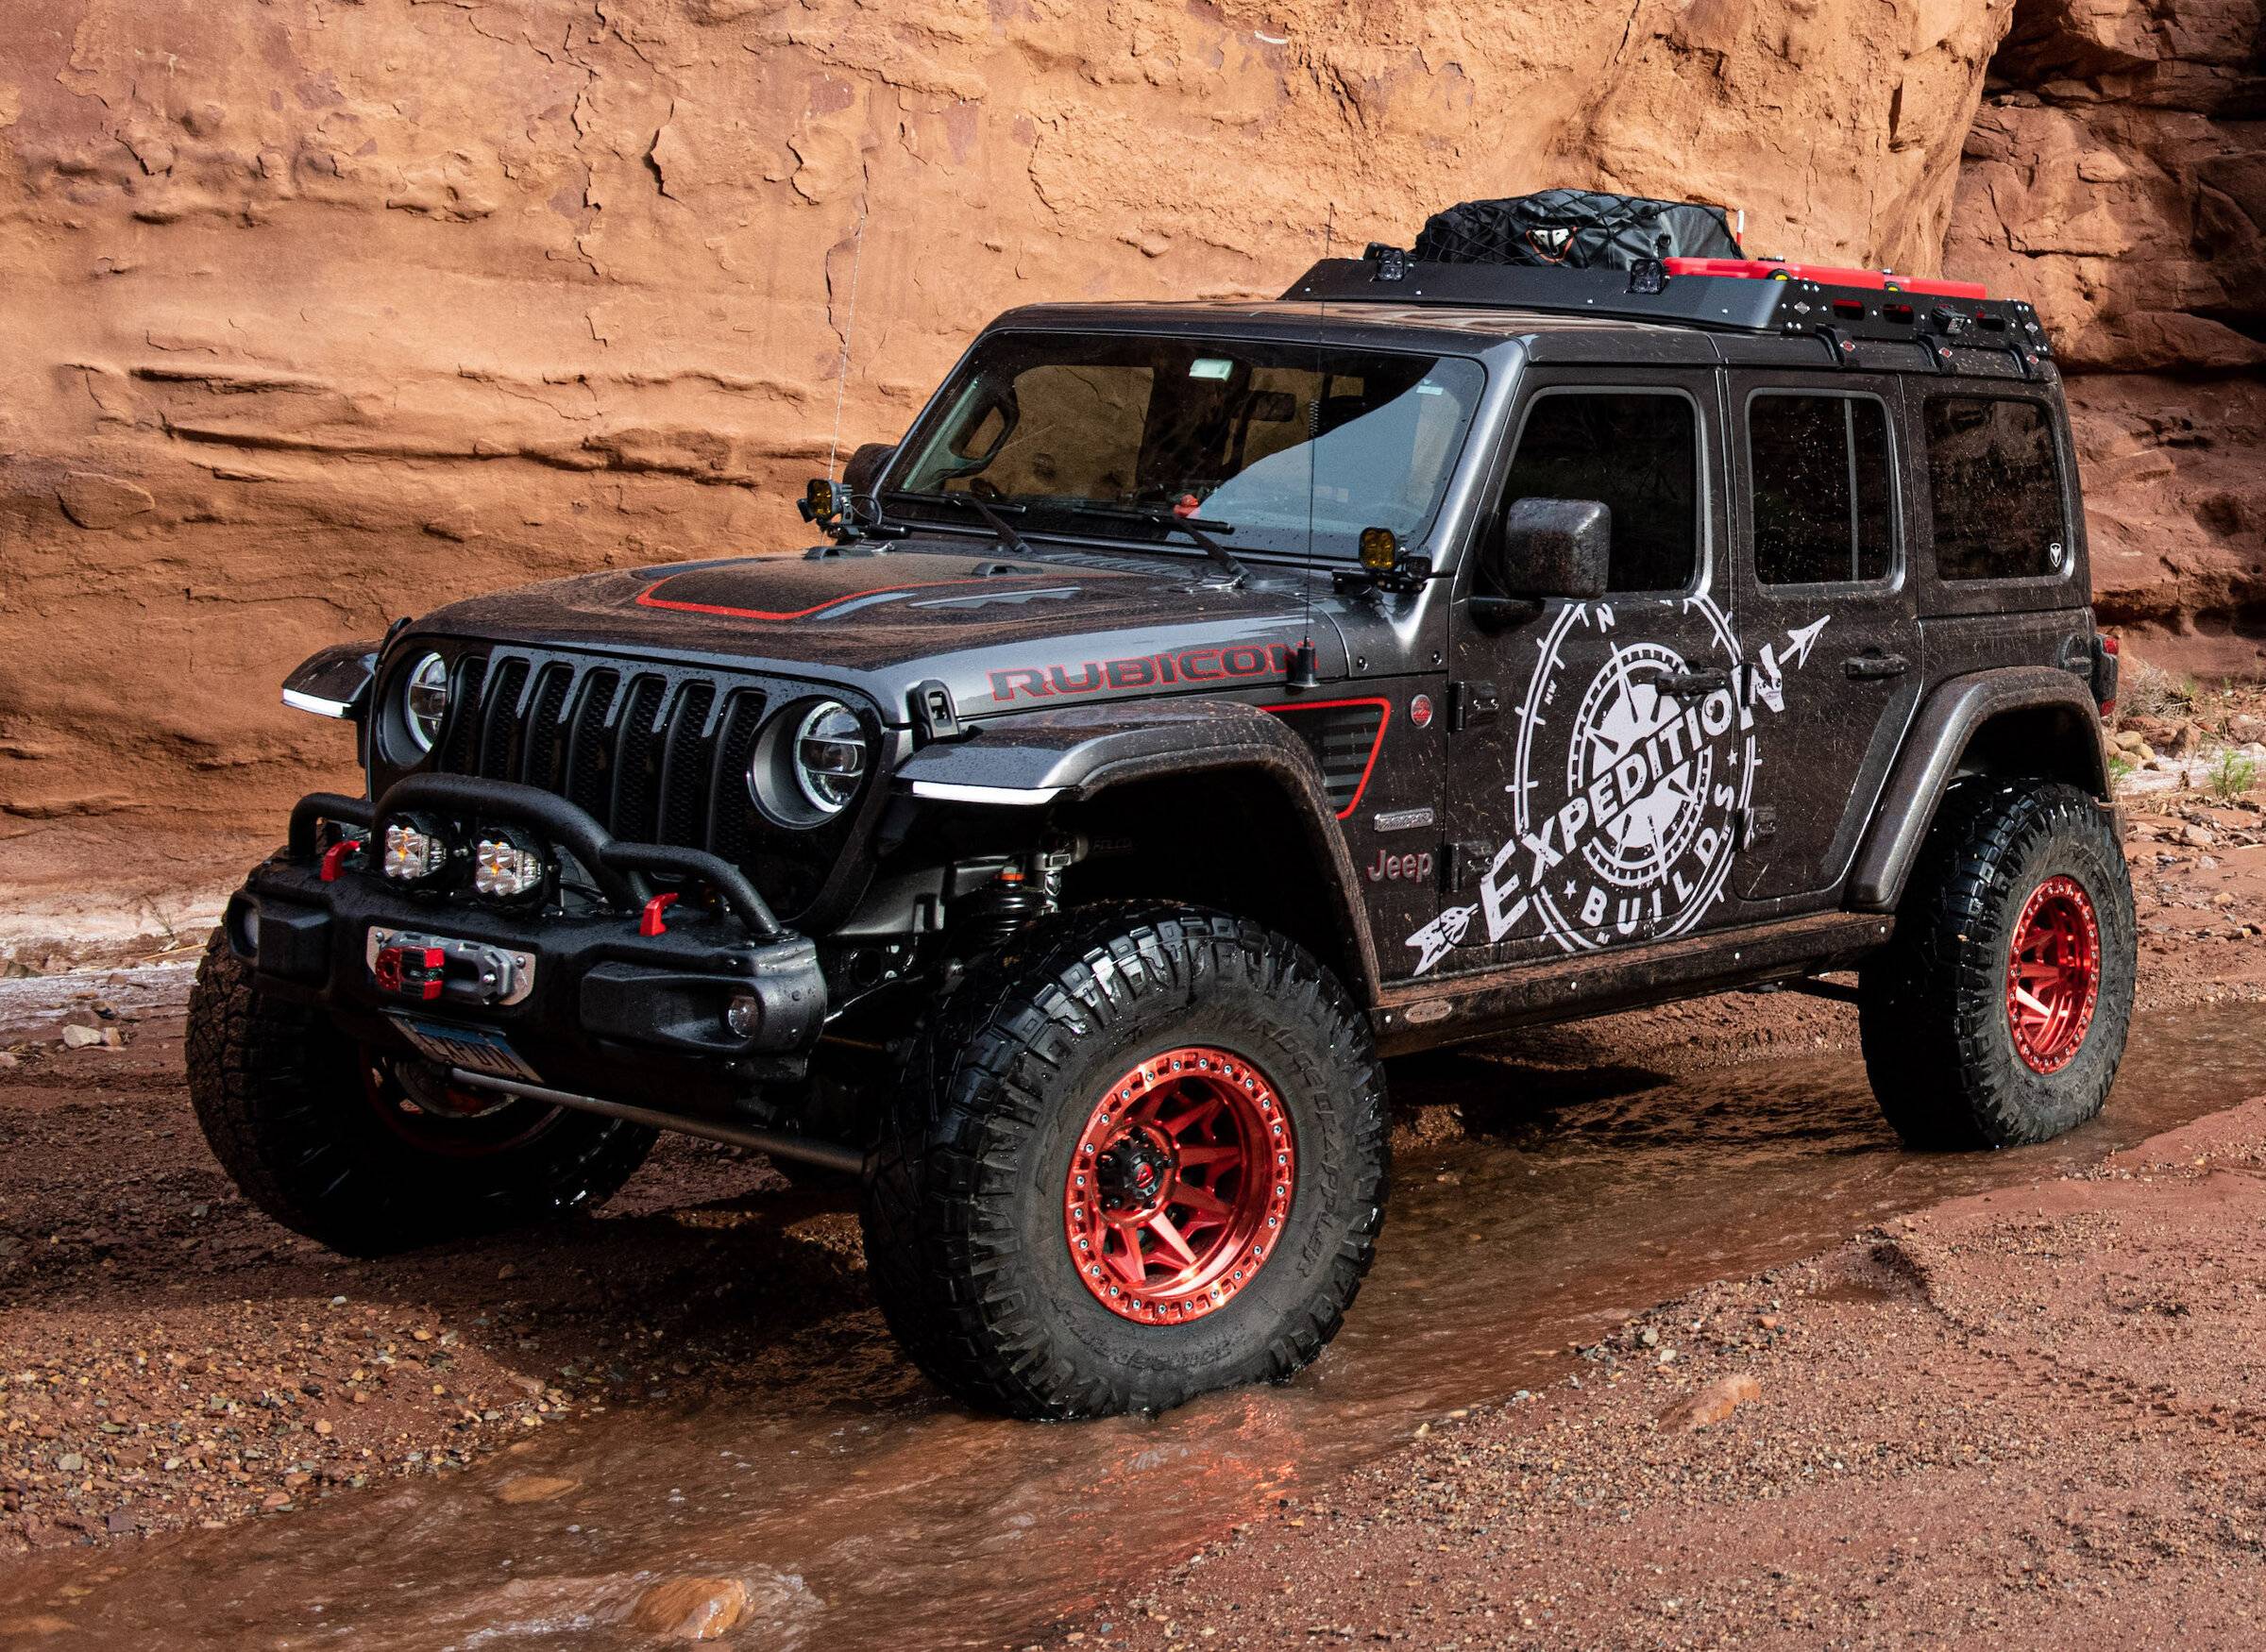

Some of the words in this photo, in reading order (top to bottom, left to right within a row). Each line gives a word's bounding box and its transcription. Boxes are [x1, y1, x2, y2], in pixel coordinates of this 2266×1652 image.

[1596, 602, 1615, 633] N
[986, 639, 1320, 701] RUBICON
[1480, 643, 1785, 942] EXPEDITION
[1367, 850, 1433, 883] Jeep
[1580, 783, 1734, 936] BUILDS
